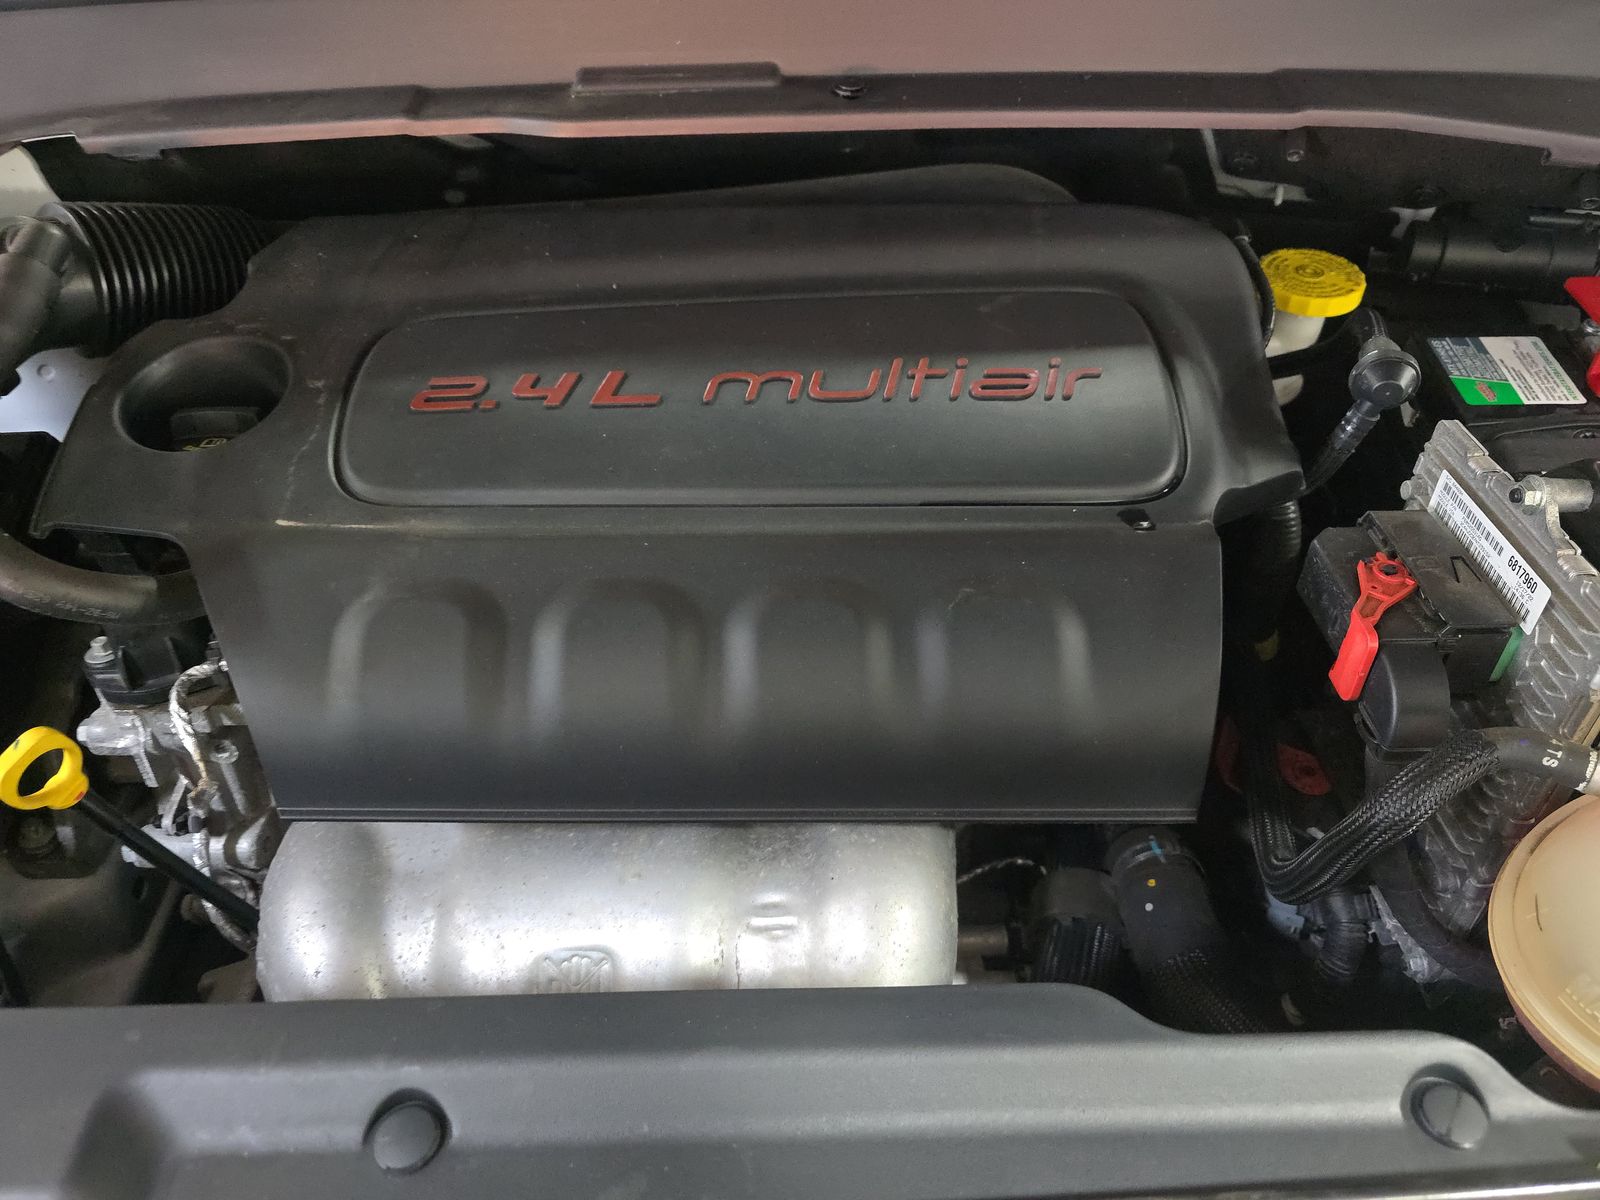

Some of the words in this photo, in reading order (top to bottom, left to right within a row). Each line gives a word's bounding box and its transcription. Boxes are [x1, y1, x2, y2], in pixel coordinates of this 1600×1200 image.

[409, 369, 663, 412] 2.4L
[702, 356, 1102, 404] multiair
[1507, 555, 1538, 594] 6817960
